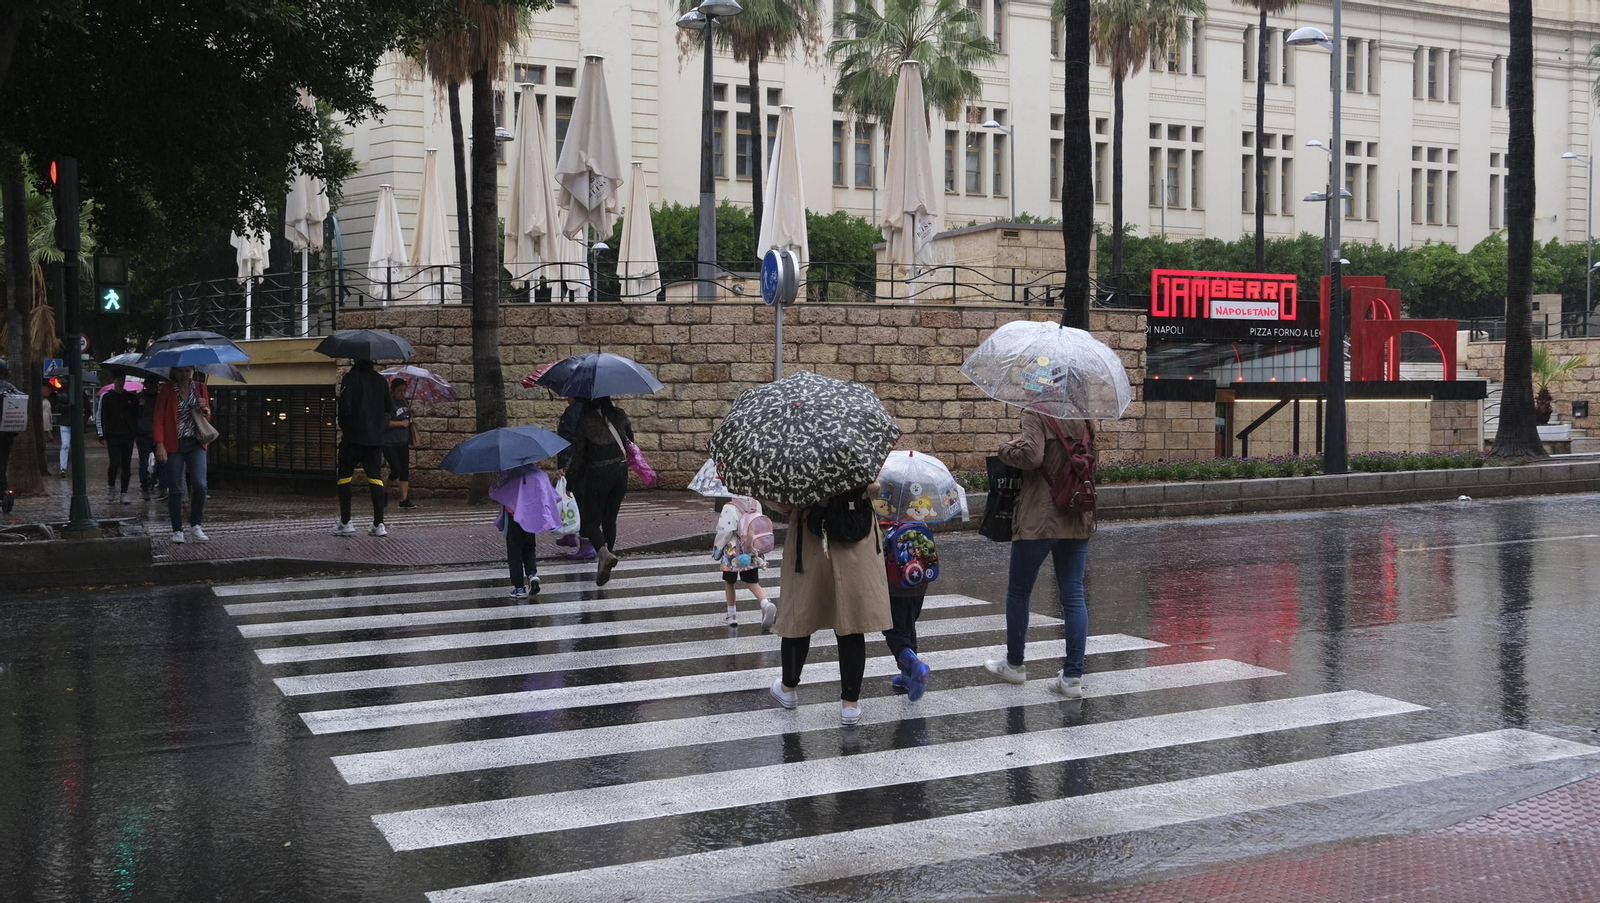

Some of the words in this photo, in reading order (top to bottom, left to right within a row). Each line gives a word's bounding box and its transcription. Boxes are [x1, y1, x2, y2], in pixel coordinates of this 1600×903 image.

[1215, 305, 1277, 317] NAPOLETANO
[1154, 325, 1184, 334] NAPOLI
[1249, 327, 1272, 336] PIZZA
[1273, 328, 1301, 337] FORNO
[1303, 329, 1309, 337] A
